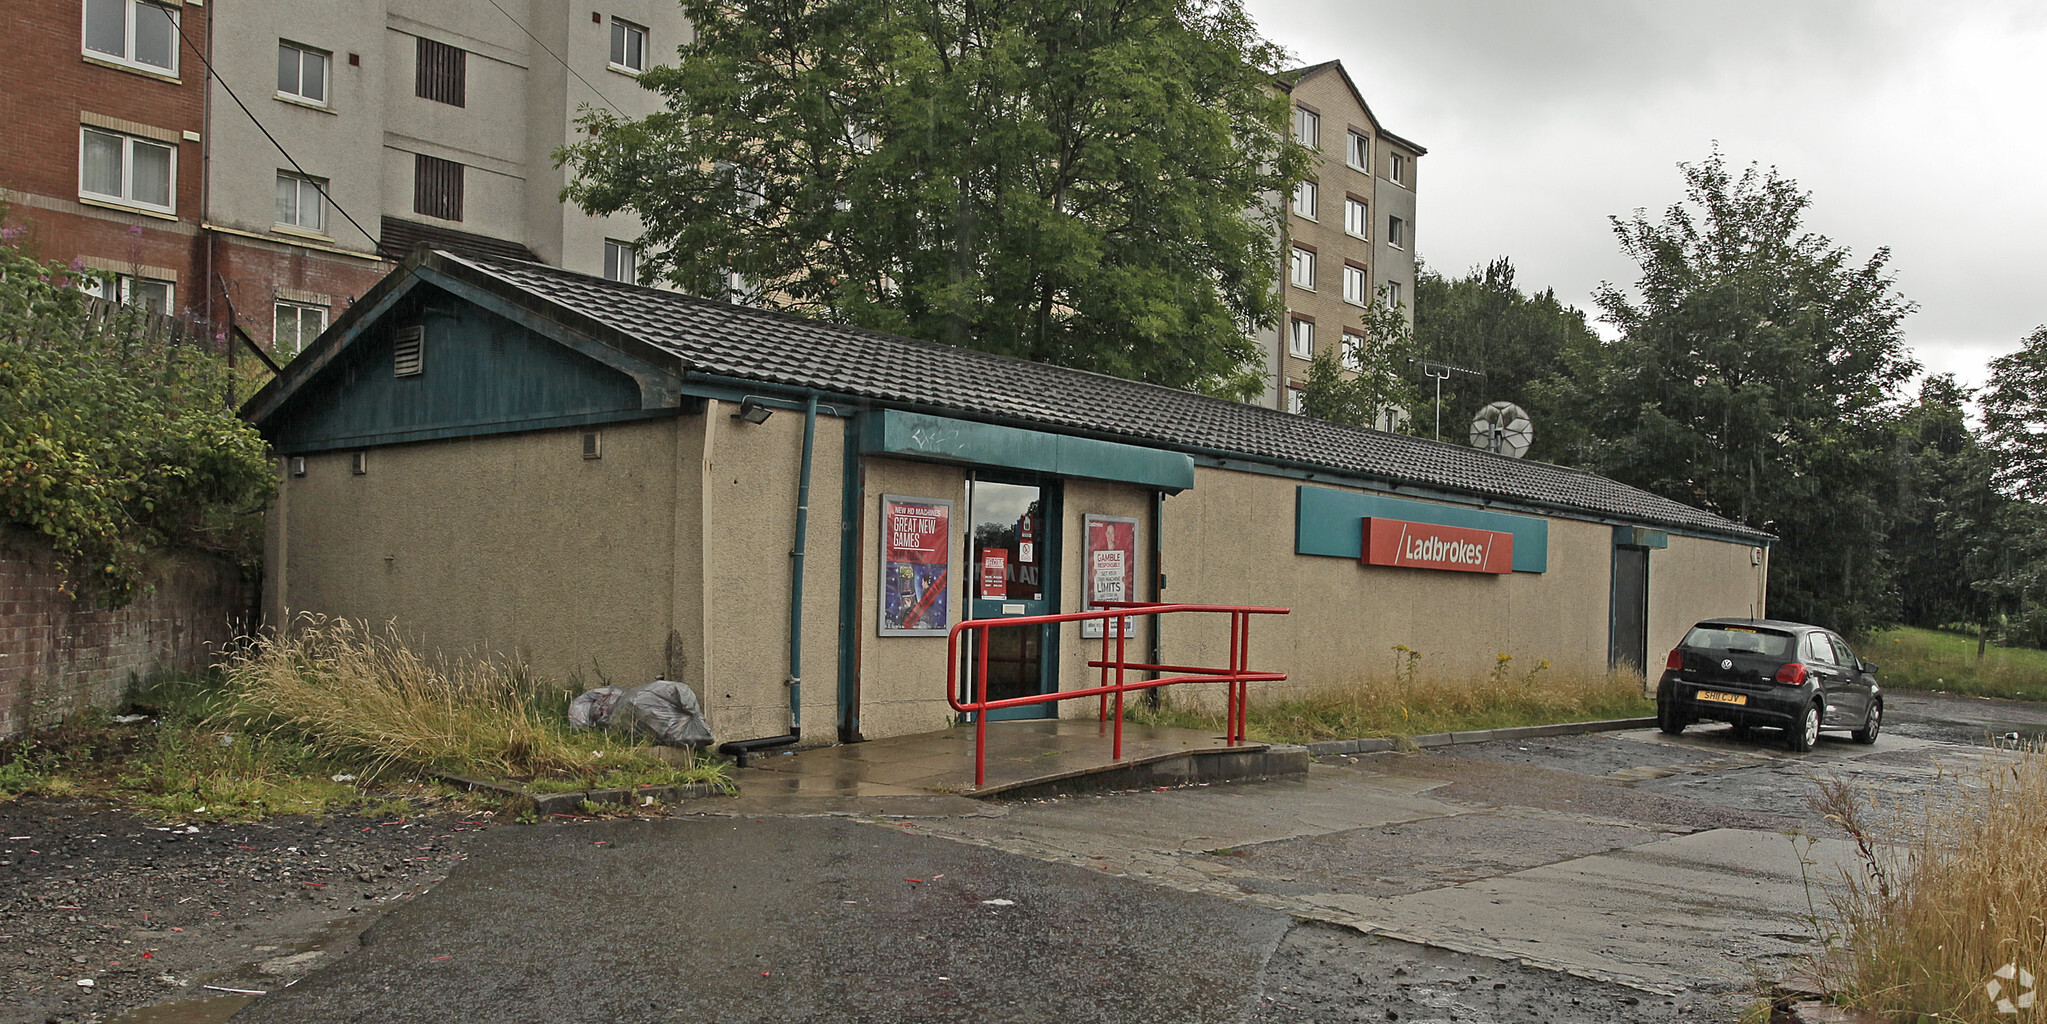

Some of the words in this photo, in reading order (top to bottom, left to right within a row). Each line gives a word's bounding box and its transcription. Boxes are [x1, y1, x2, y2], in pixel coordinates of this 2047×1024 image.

[895, 506, 907, 514] NEW
[907, 507, 915, 515] HD
[915, 508, 941, 517] MACHINES
[893, 517, 917, 533] GREAT
[919, 519, 936, 534] NEW
[893, 532, 920, 548] GAMES
[1405, 534, 1483, 565] Ladbrokes
[1097, 553, 1121, 562] GAMBLE
[1096, 581, 1121, 593] LIMITS
[1721, 693, 1739, 702] CJV
